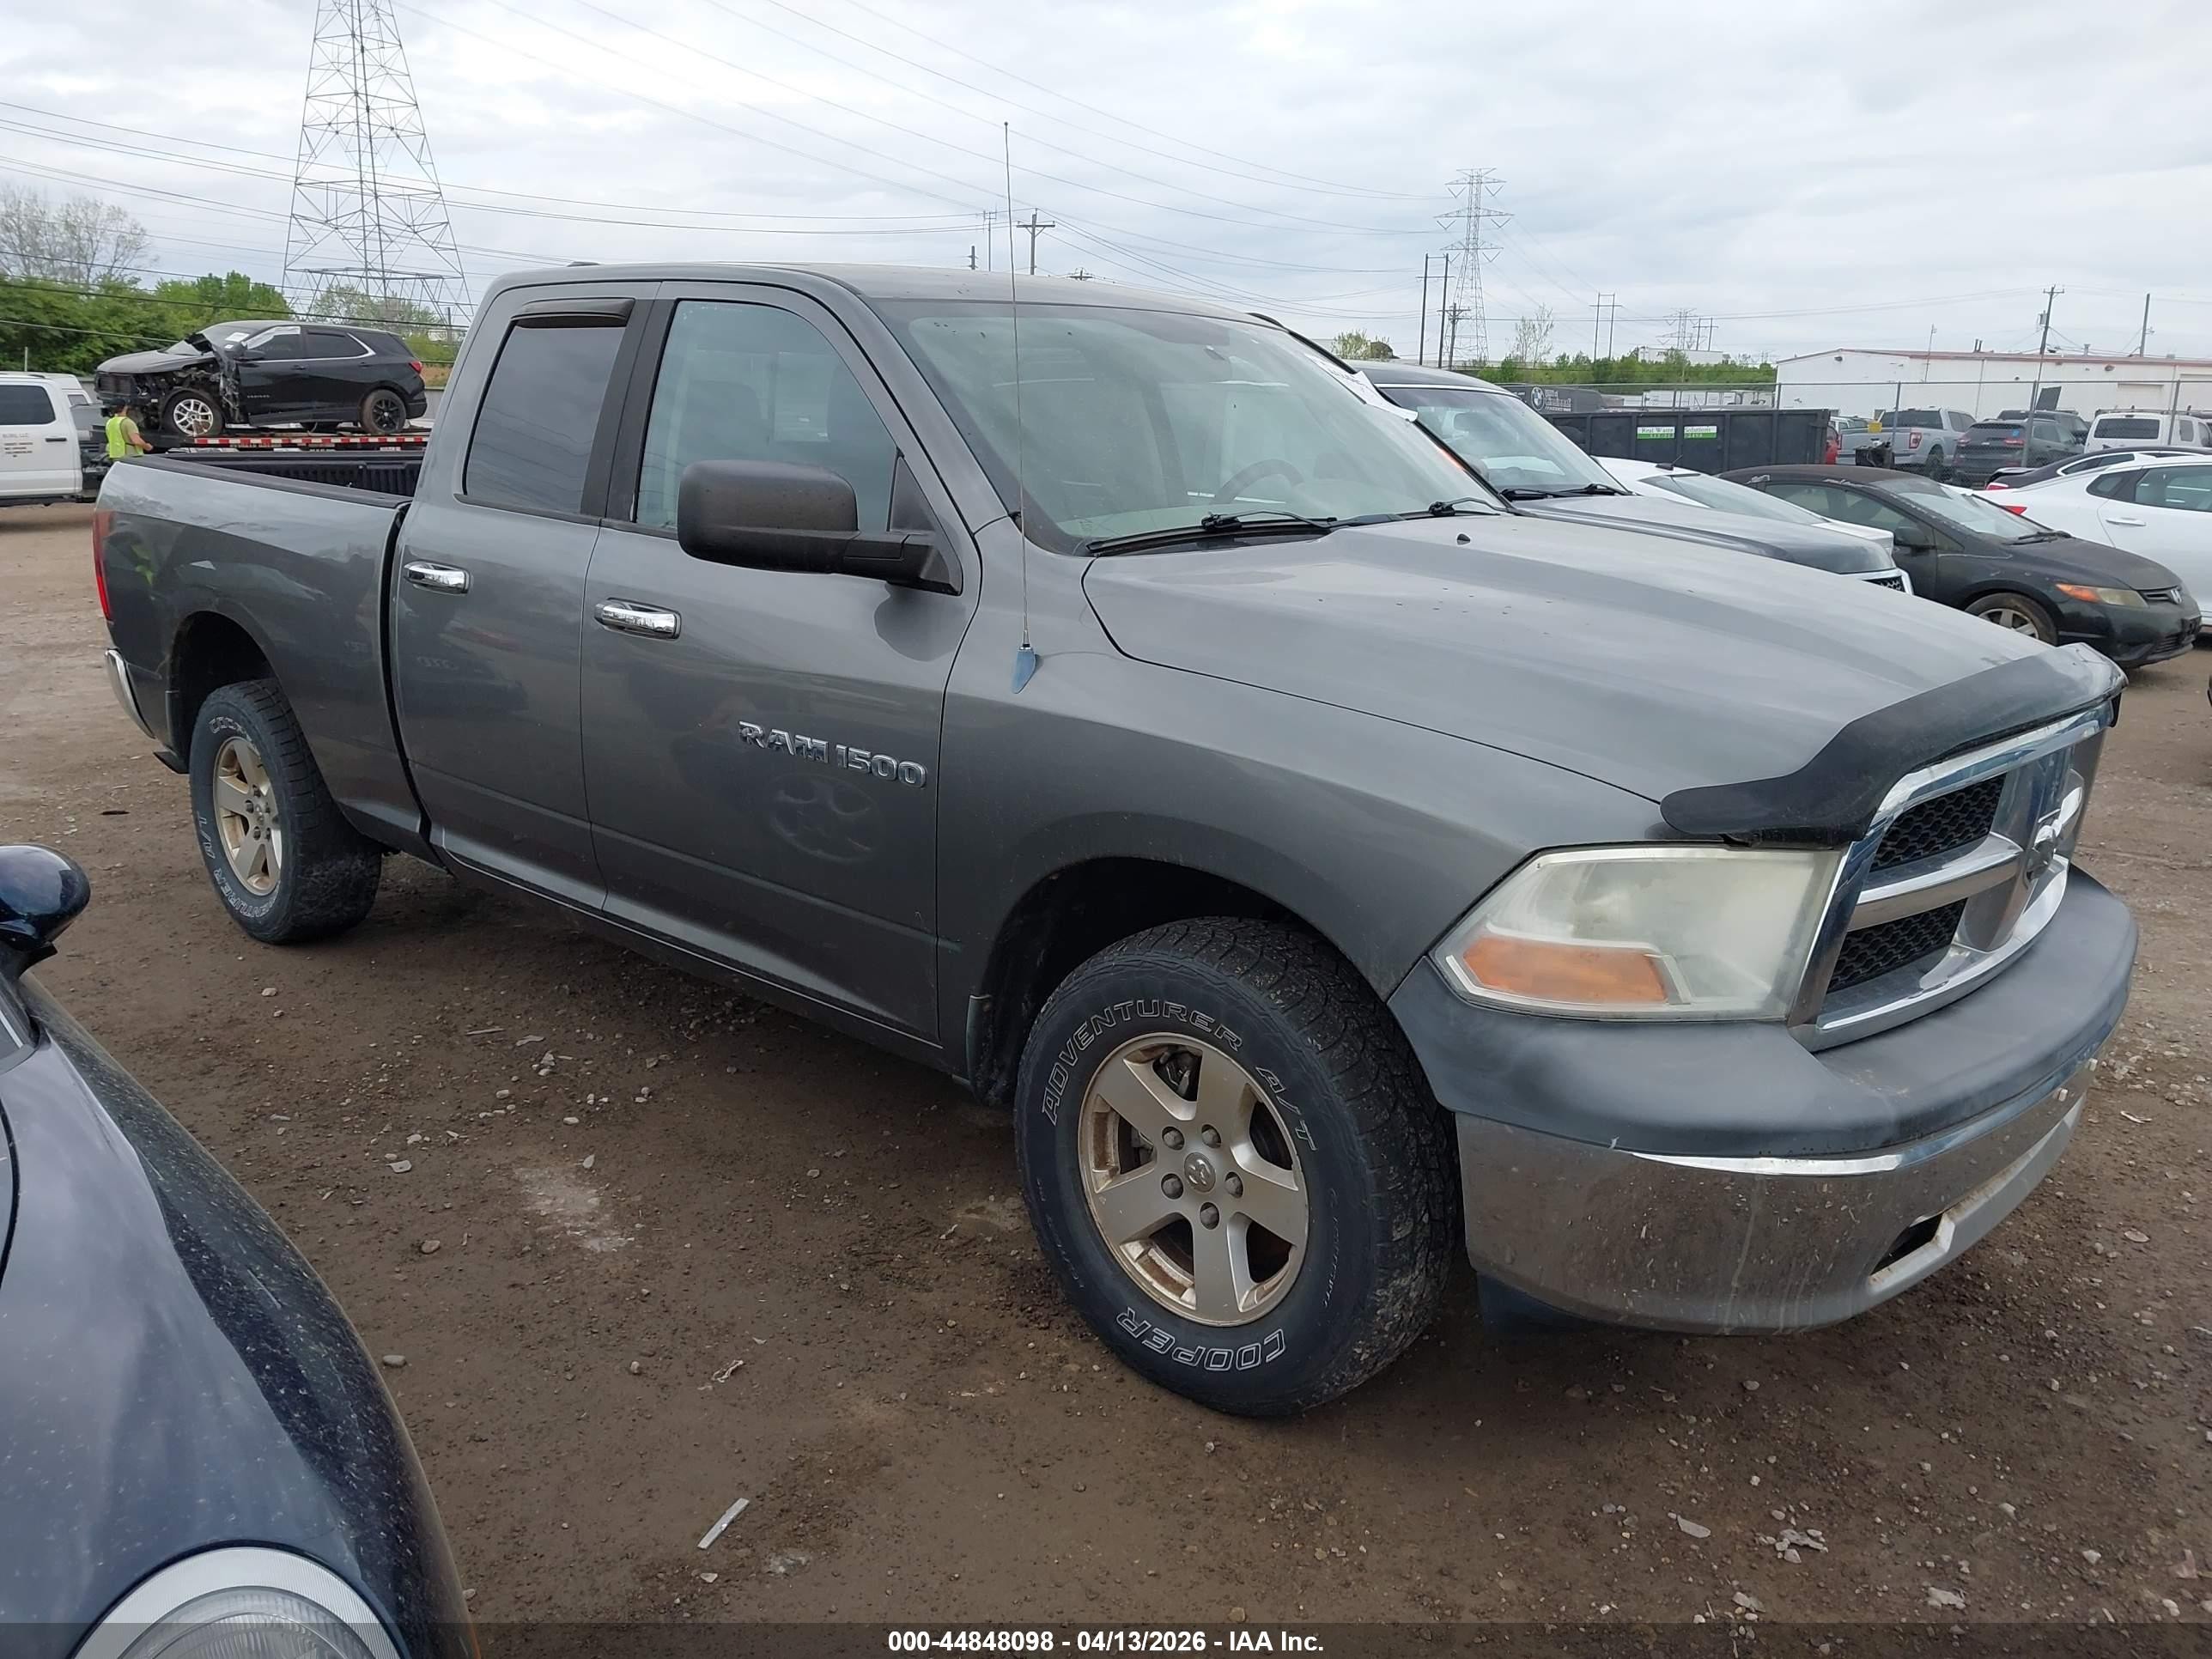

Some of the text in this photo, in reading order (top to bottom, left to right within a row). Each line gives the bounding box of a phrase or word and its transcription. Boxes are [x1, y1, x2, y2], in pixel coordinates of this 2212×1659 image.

[738, 720, 927, 788] RAM 1500
[213, 866, 281, 918] ENTURER
[1041, 999, 1317, 1151] ADVENTURER A/T
[1115, 1306, 1285, 1371] COOPER
